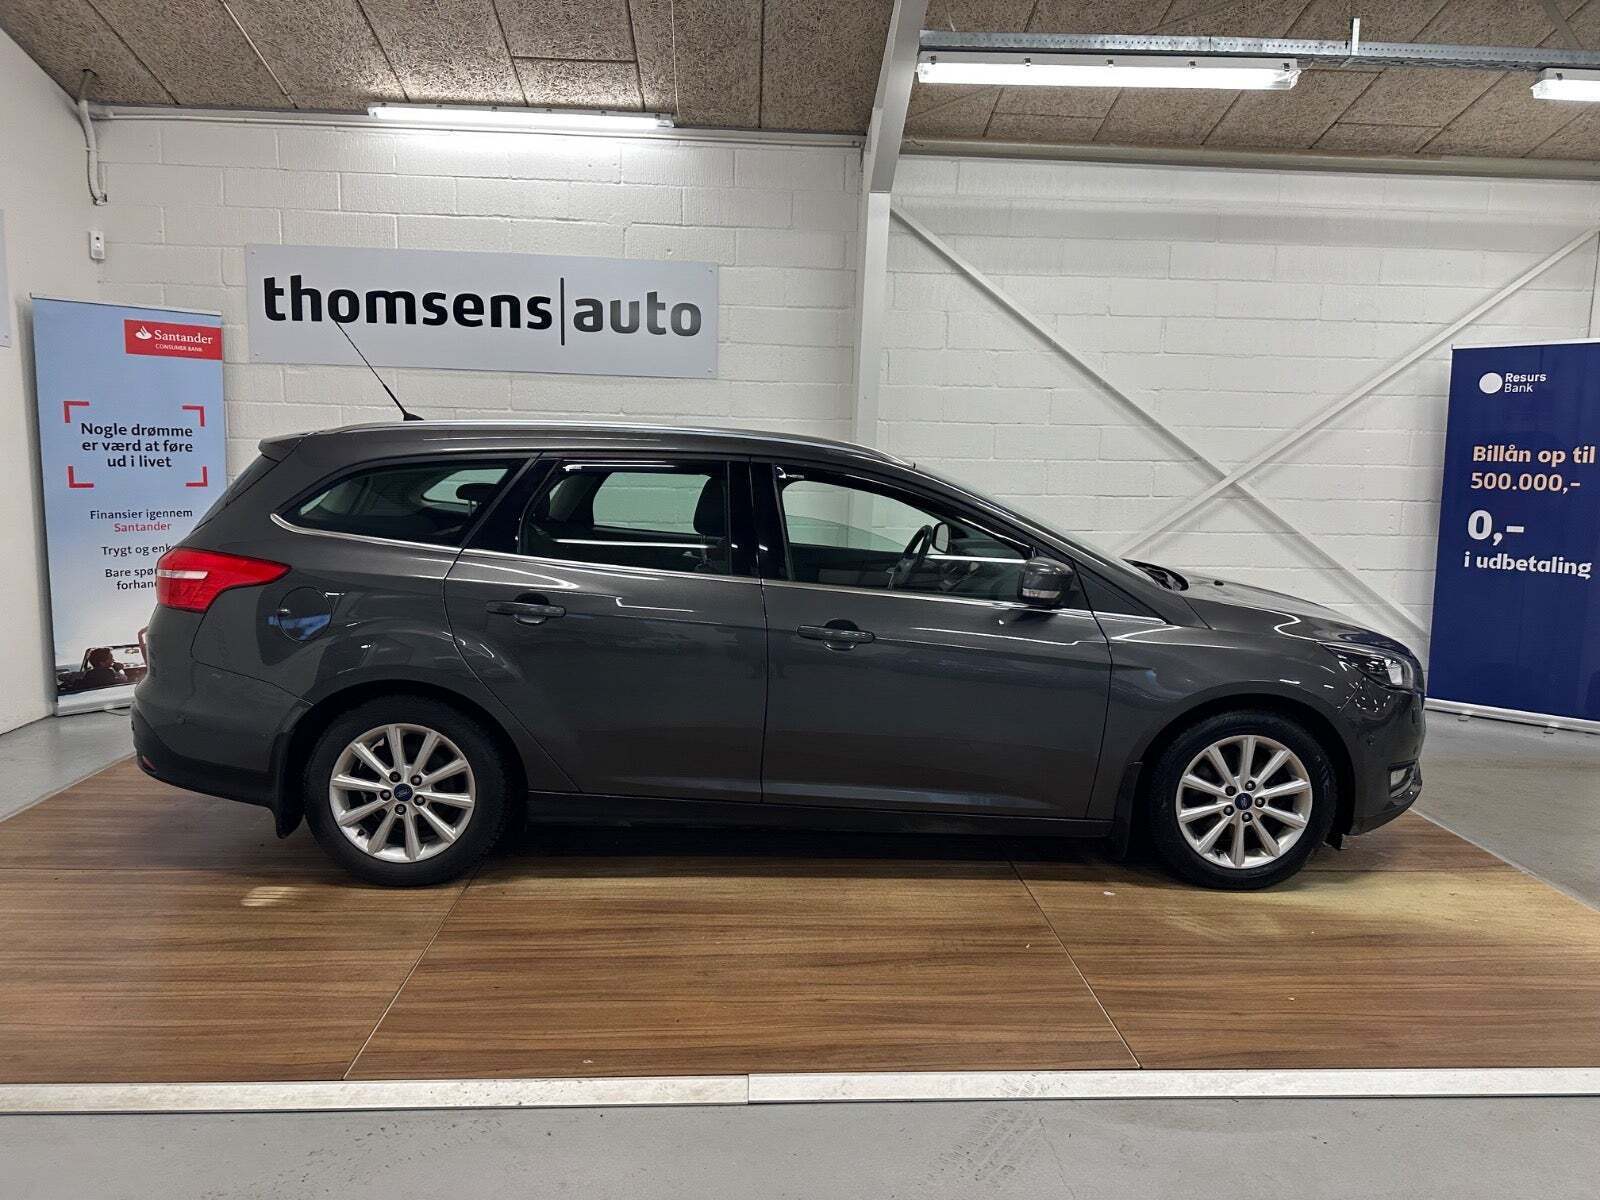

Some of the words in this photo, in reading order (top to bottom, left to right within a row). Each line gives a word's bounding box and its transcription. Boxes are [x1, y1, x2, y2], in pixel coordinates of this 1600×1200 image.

[263, 275, 552, 330] thomsens
[574, 291, 702, 336] auto
[154, 329, 213, 344] Santander
[1505, 372, 1547, 383] Resurs
[1504, 383, 1533, 393] Bank
[81, 422, 127, 438] Nogle
[131, 424, 193, 437] drømme
[82, 441, 98, 451] er
[102, 440, 141, 452] værd
[145, 441, 160, 452] at
[163, 440, 193, 452] føre
[107, 455, 126, 468] ud
[130, 455, 135, 468] i
[139, 455, 172, 468] livet
[1473, 444, 1531, 463] Billån
[1537, 453, 1566, 467] op
[1573, 446, 1595, 464] til
[1470, 472, 1581, 494] 500.000,-
[90, 510, 142, 519] Finansier
[146, 509, 192, 520] igennem
[114, 522, 171, 532] Santander
[101, 545, 132, 557] Trygt
[135, 546, 150, 556] og
[151, 543, 174, 553] enk
[1464, 551, 1470, 567] i
[1476, 553, 1592, 580] udbetaling
[105, 568, 131, 578] Bare
[116, 580, 157, 590] forhan
